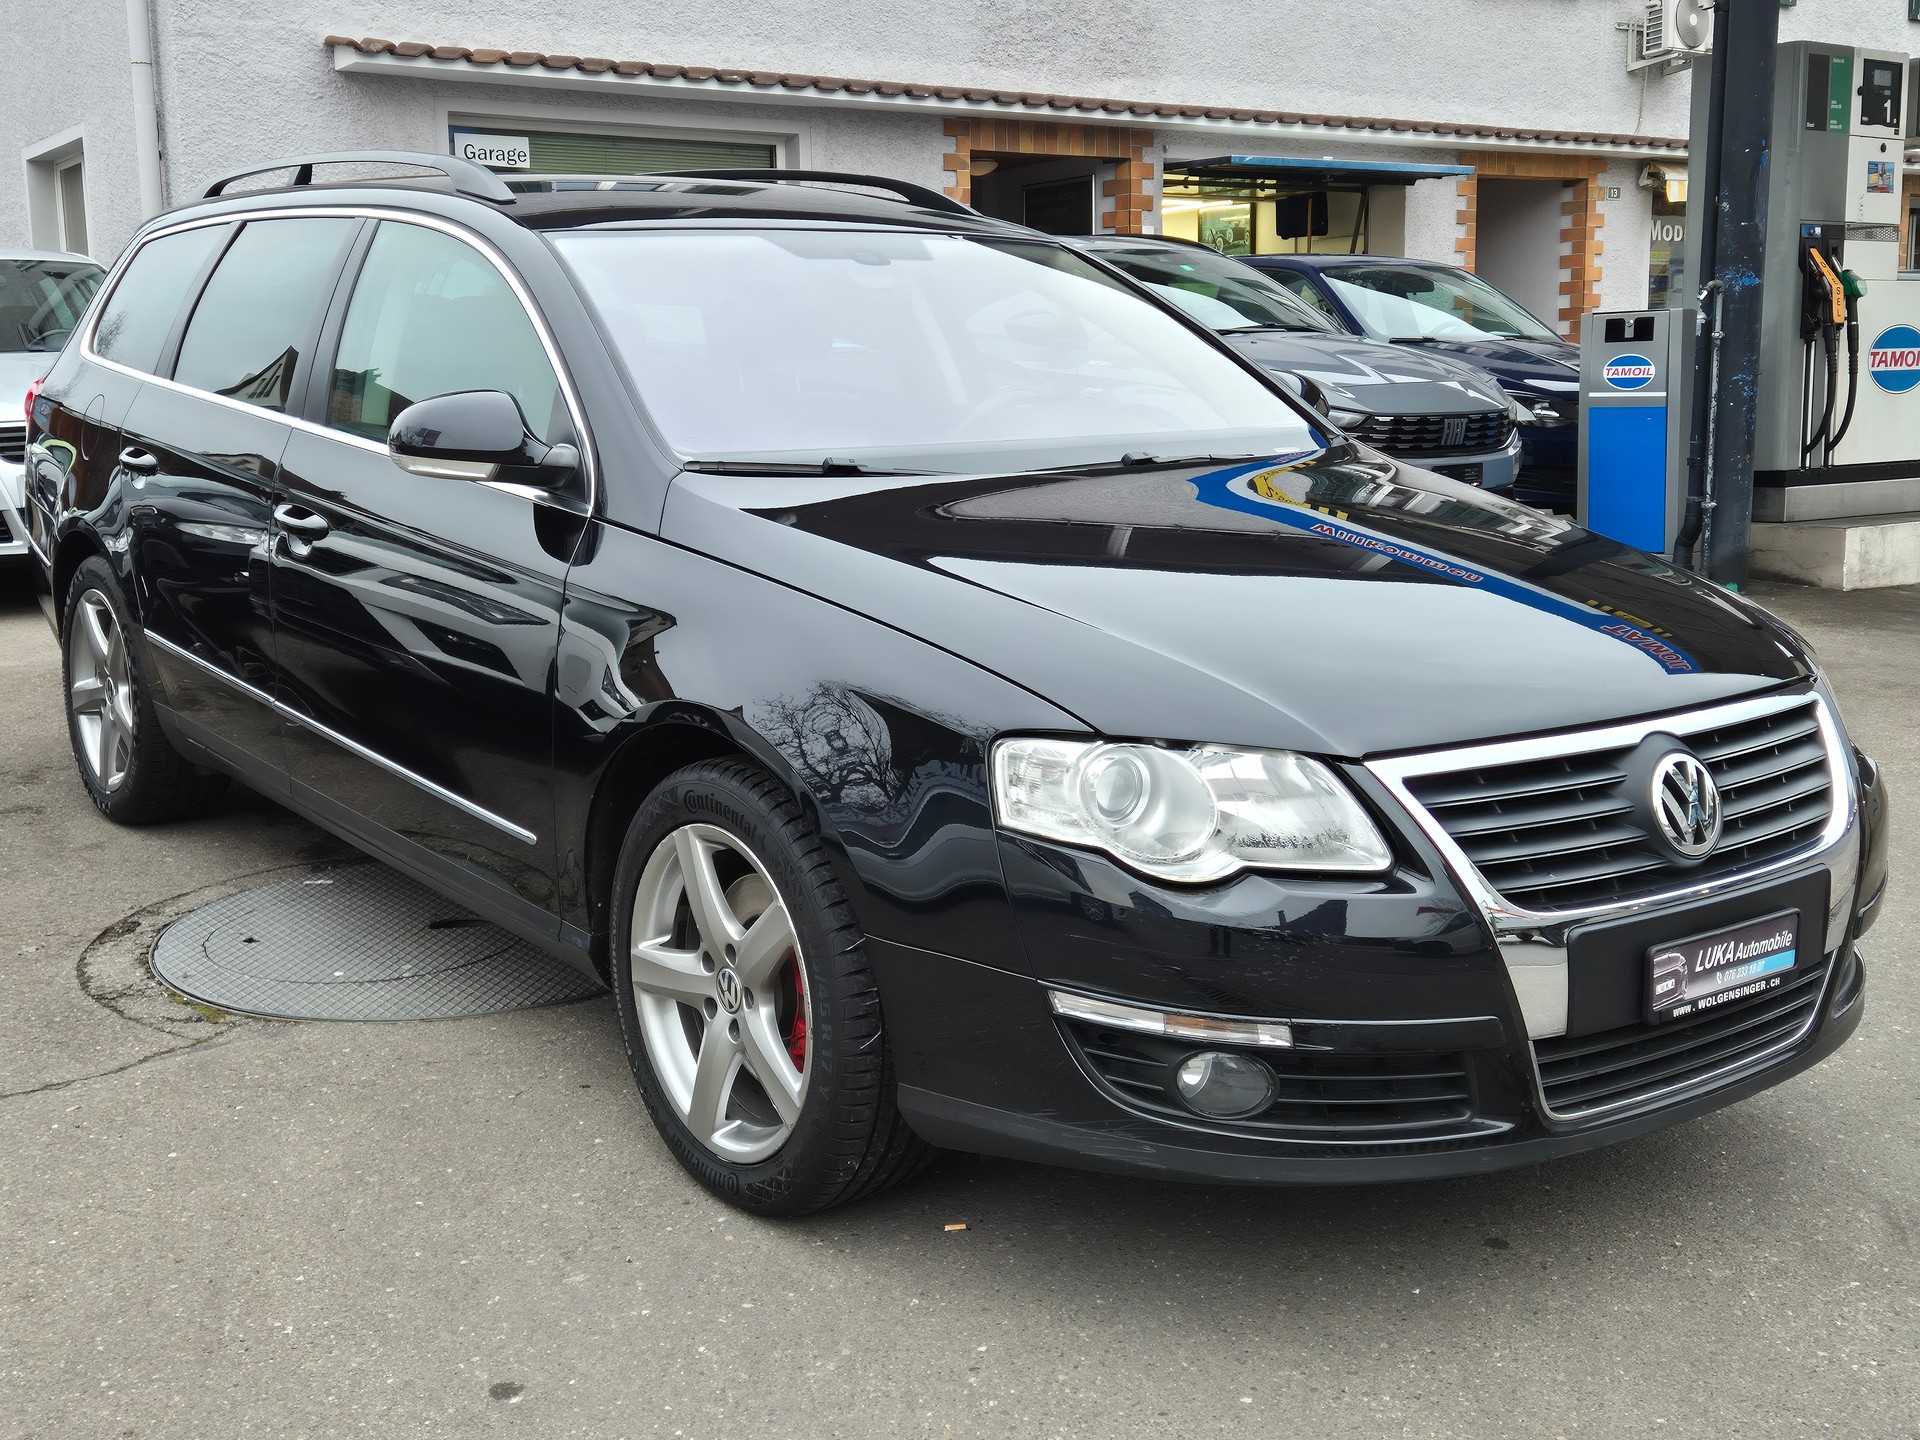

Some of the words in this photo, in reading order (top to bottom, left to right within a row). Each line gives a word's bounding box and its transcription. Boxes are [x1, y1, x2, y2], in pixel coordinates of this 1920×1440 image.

[1883, 99, 1892, 123] 1
[463, 143, 528, 166] Garage
[1651, 219, 1686, 241] MOD
[1820, 260, 1842, 317] DIESEL
[1870, 350, 1920, 368] TAMOI
[1605, 367, 1654, 377] TAMOIL
[683, 789, 758, 842] Continental
[1695, 940, 1735, 973] LUKA
[1734, 930, 1793, 961] Automobile
